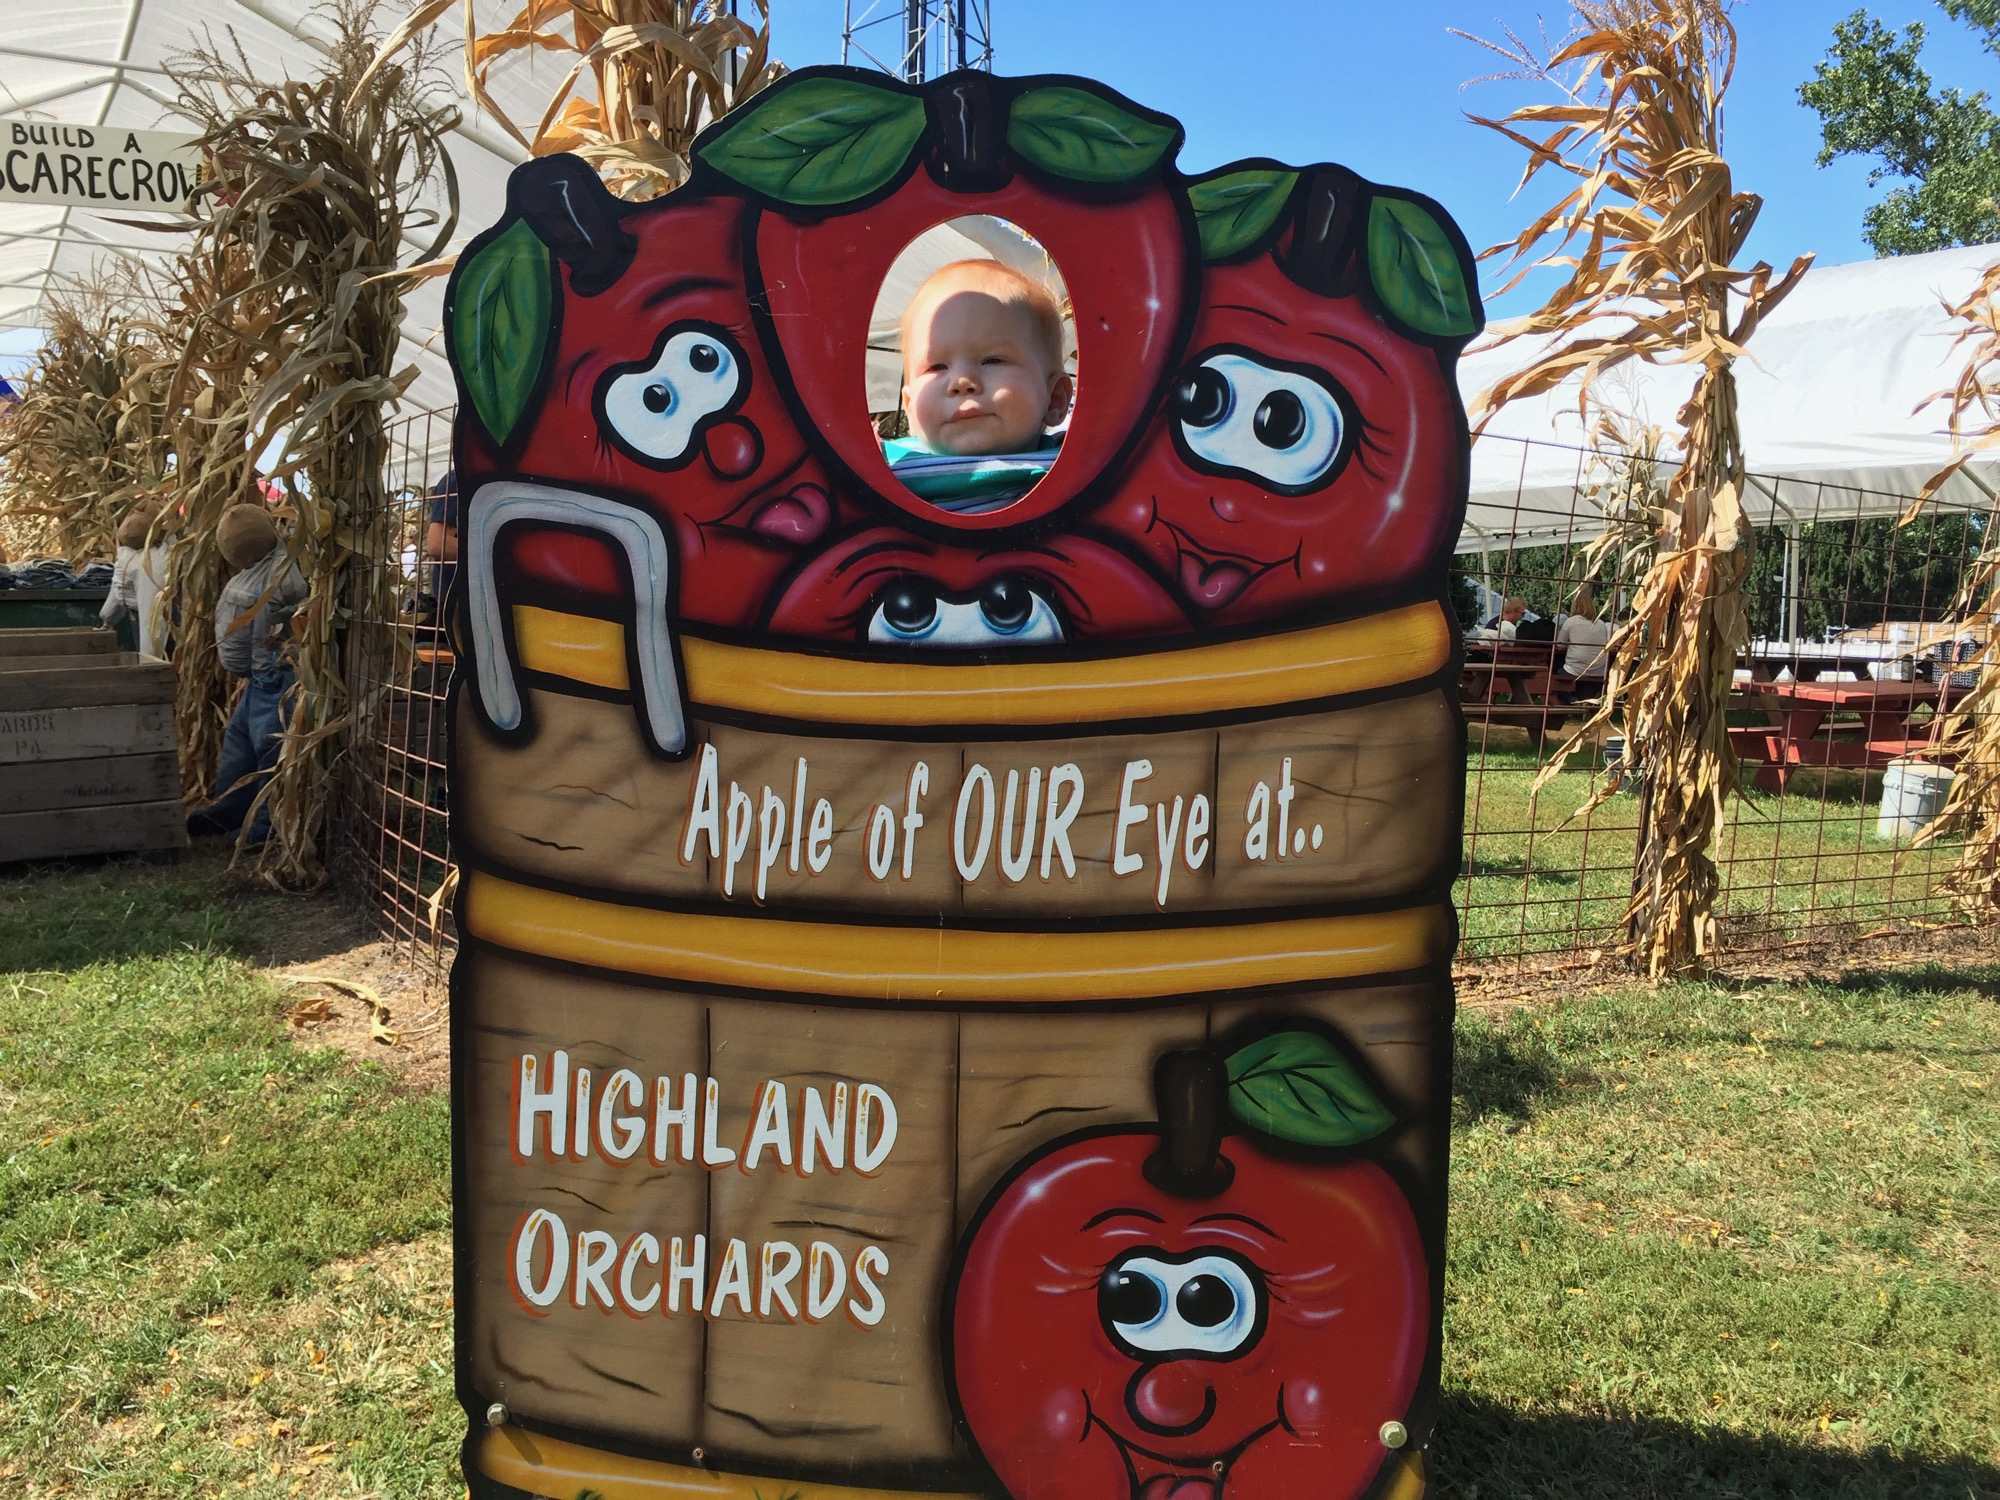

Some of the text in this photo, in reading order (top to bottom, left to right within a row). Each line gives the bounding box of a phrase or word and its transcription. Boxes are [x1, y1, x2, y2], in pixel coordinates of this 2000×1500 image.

[0, 149, 201, 204] CARECROW
[12, 123, 141, 153] BUILD A
[681, 743, 832, 901] Apple
[864, 760, 929, 881] of
[950, 763, 1085, 884] OUR
[1110, 758, 1210, 907] Eye
[511, 1049, 899, 1177] HIGHLAND
[508, 1207, 890, 1329] ORCHARDS
